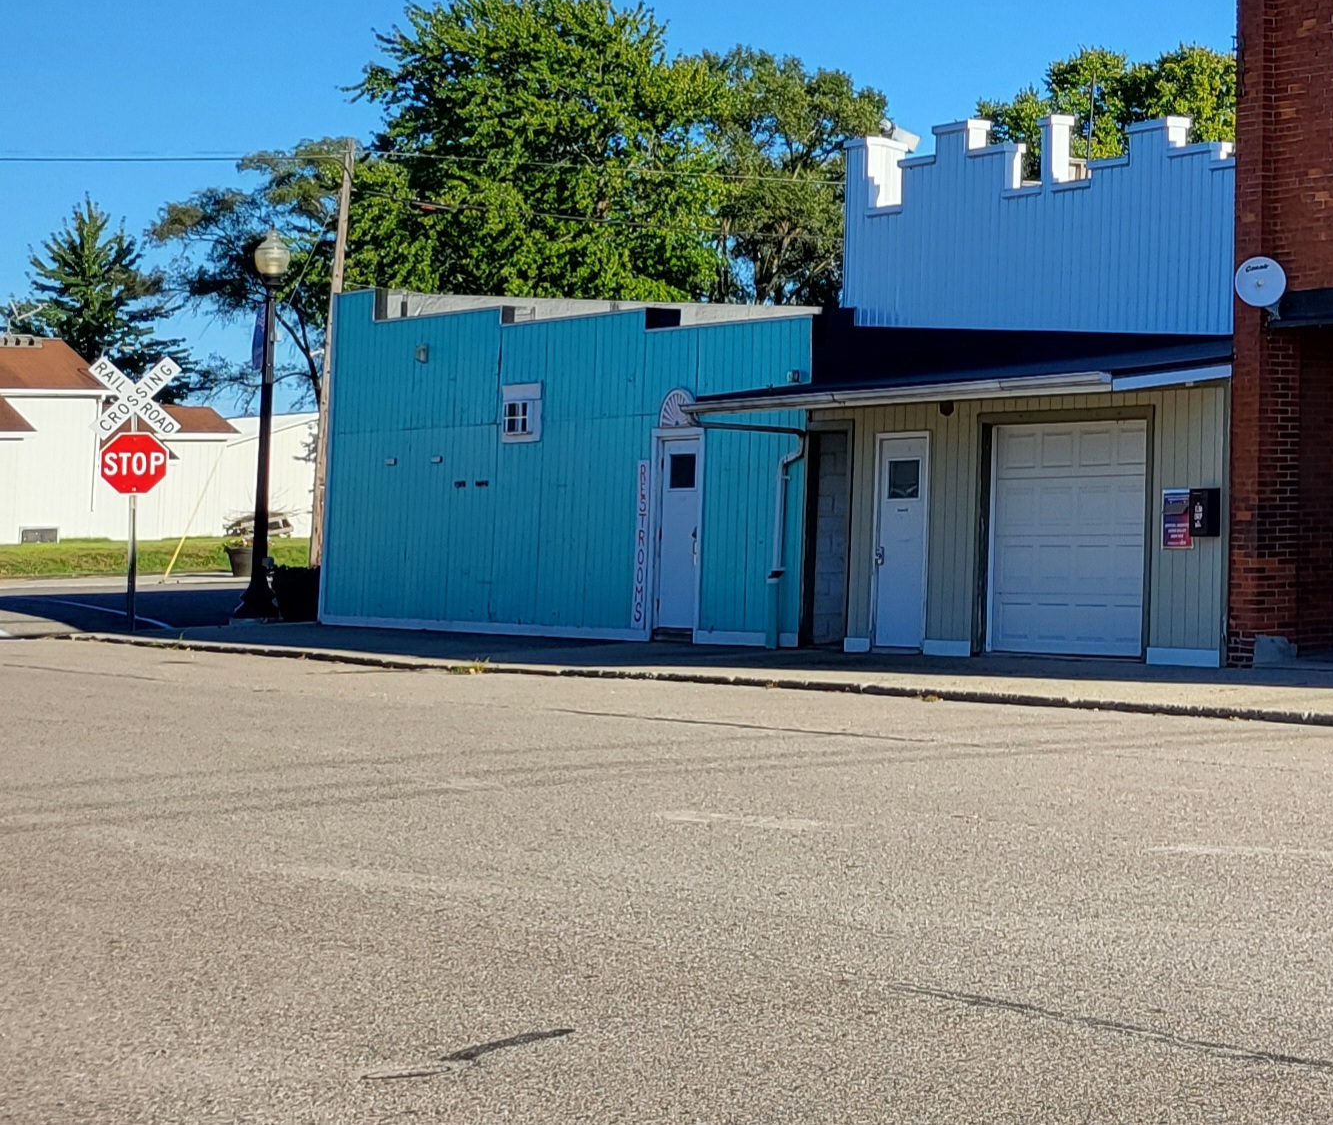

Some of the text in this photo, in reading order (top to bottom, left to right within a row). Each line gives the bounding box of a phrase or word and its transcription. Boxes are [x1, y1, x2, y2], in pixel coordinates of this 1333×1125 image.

[94, 361, 125, 393] RAIL
[100, 364, 173, 432] CROSSING
[140, 402, 175, 434] ROAD
[103, 452, 165, 476] STOP
[633, 464, 648, 623] RESTROOMS
